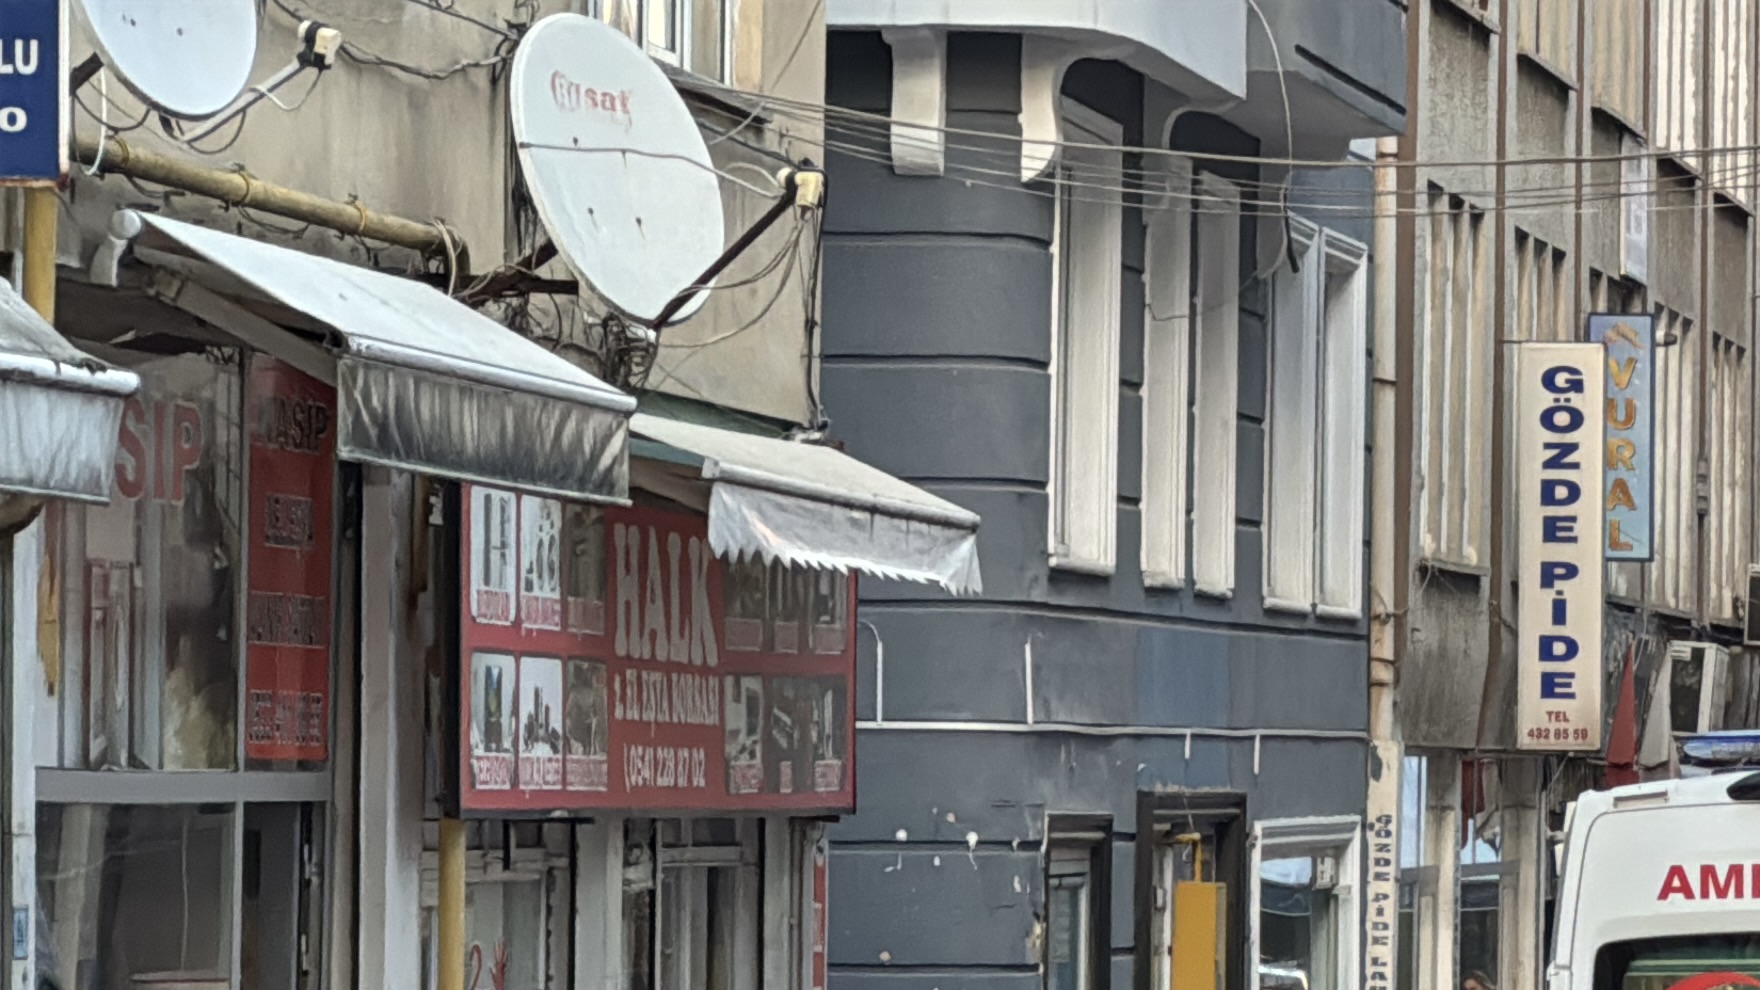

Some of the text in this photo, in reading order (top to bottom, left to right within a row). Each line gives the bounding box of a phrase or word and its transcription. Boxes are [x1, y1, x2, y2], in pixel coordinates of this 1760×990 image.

[1606, 356, 1638, 552] VURAL
[1538, 364, 1585, 700] GÖZDE PİDE
[613, 522, 719, 668] HALK
[1527, 727, 1551, 740] 432
[1545, 710, 1571, 723] TEL
[1372, 813, 1393, 882] GÖZDE
